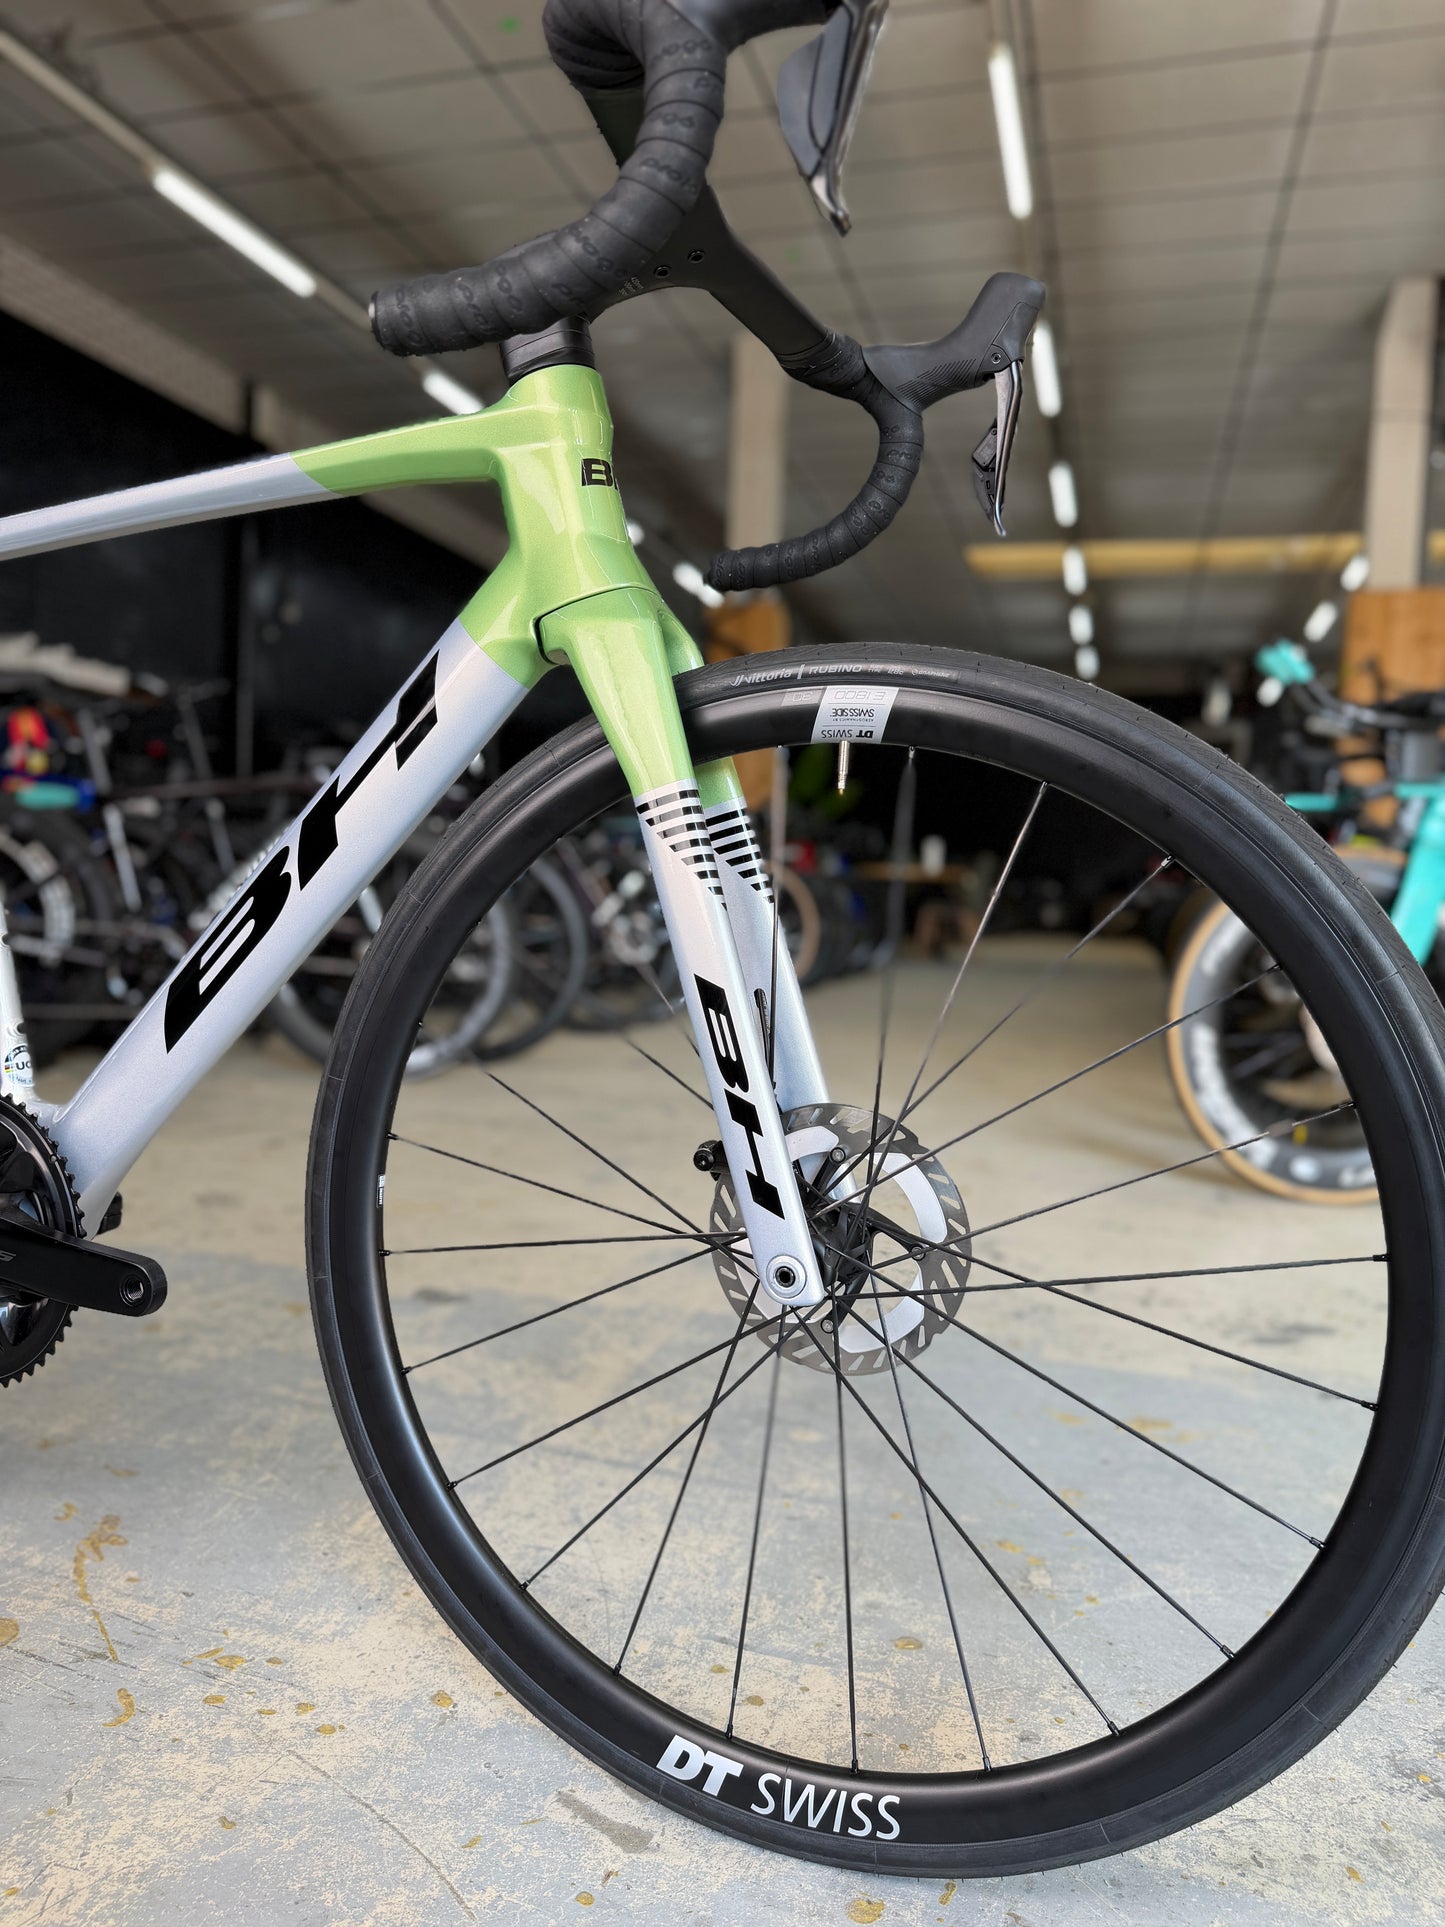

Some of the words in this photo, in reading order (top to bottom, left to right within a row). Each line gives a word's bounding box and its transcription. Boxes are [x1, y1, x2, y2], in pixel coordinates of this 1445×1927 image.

[581, 457, 618, 490] B
[740, 668, 793, 686] vittoria
[809, 664, 863, 675] RUBINO
[820, 729, 853, 739] SWISS
[856, 729, 874, 739] DT
[164, 649, 440, 1055] BH
[694, 973, 786, 1221] BH
[656, 1734, 744, 1797] DT
[750, 1772, 901, 1840] SWISS
